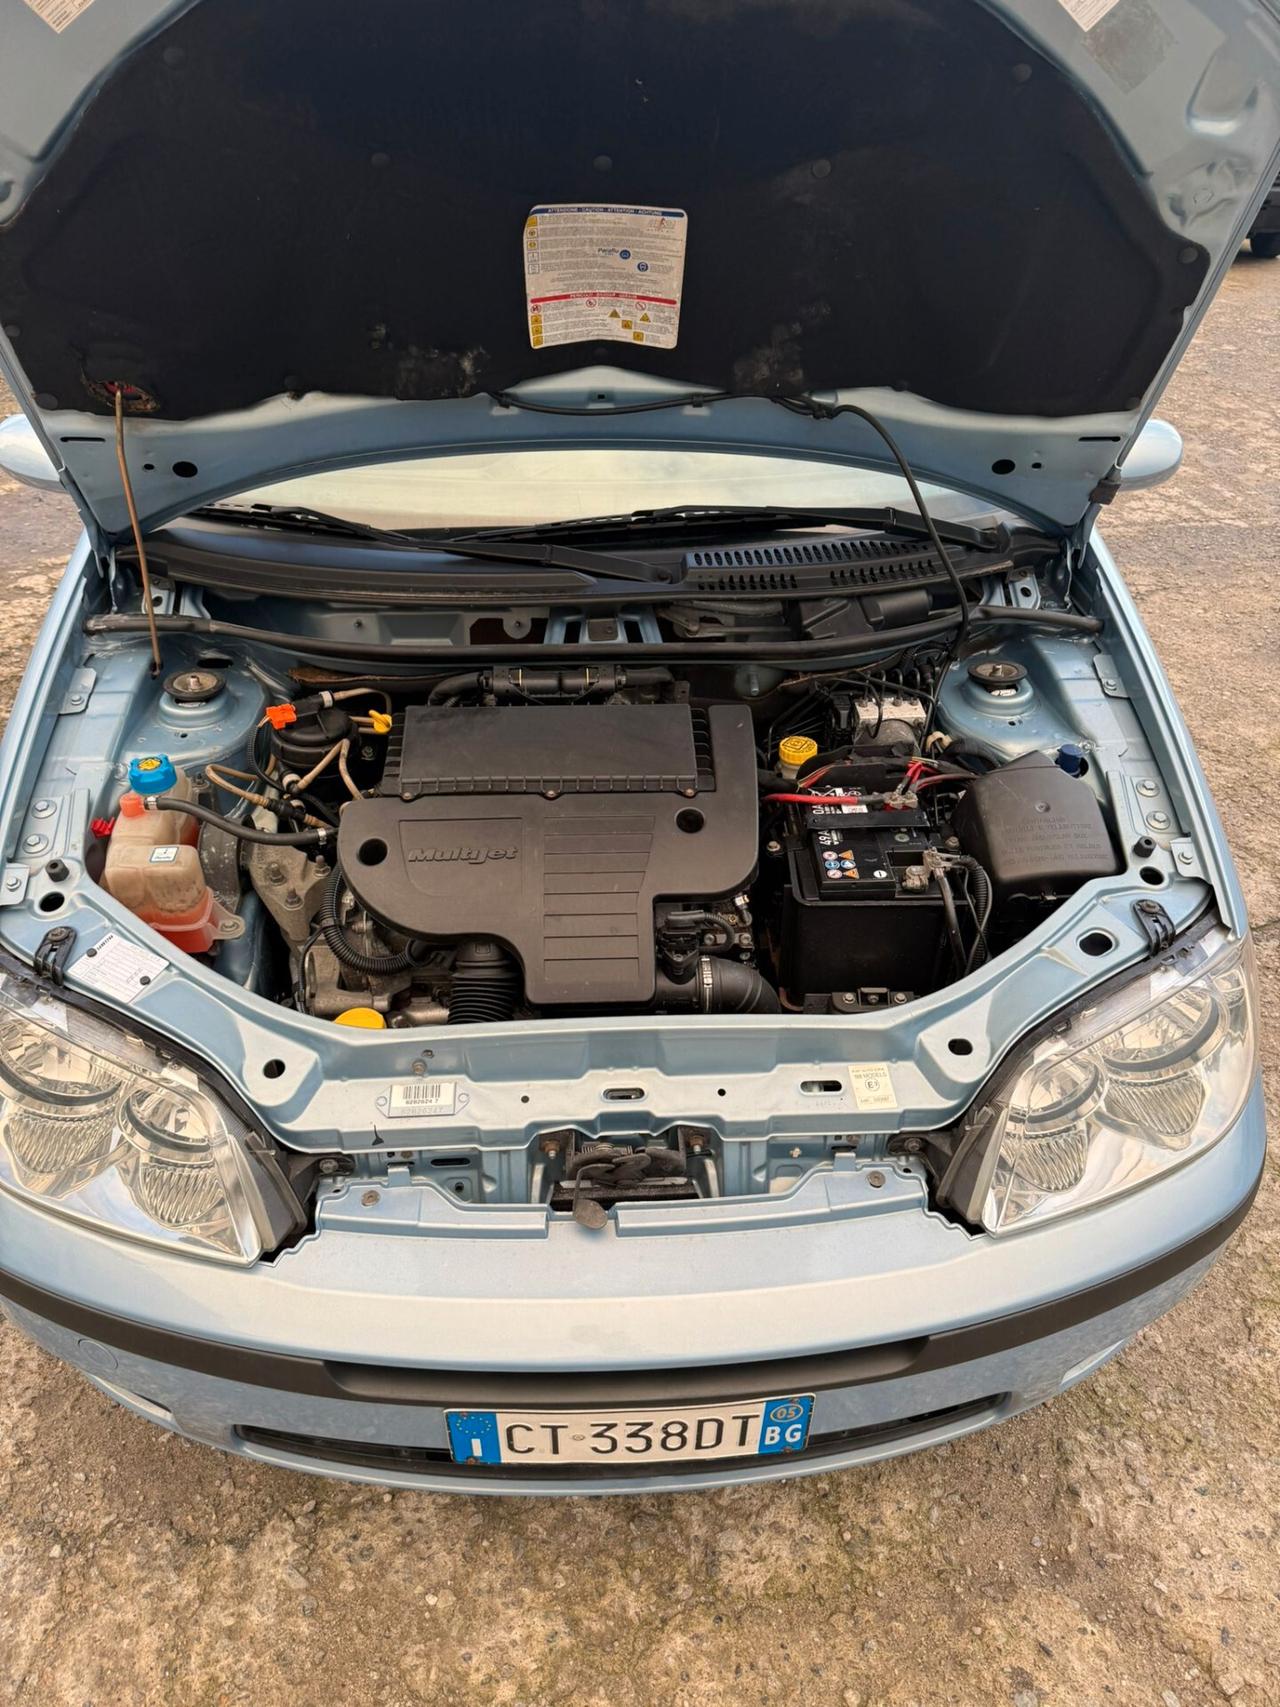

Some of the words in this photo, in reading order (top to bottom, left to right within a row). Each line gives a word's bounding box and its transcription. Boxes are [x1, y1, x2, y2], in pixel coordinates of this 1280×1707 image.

[408, 846, 518, 865] Multijet
[776, 1406, 799, 1420] 05
[505, 1423, 569, 1455] CT
[589, 1414, 761, 1455] 338DT
[763, 1423, 803, 1446] BG
